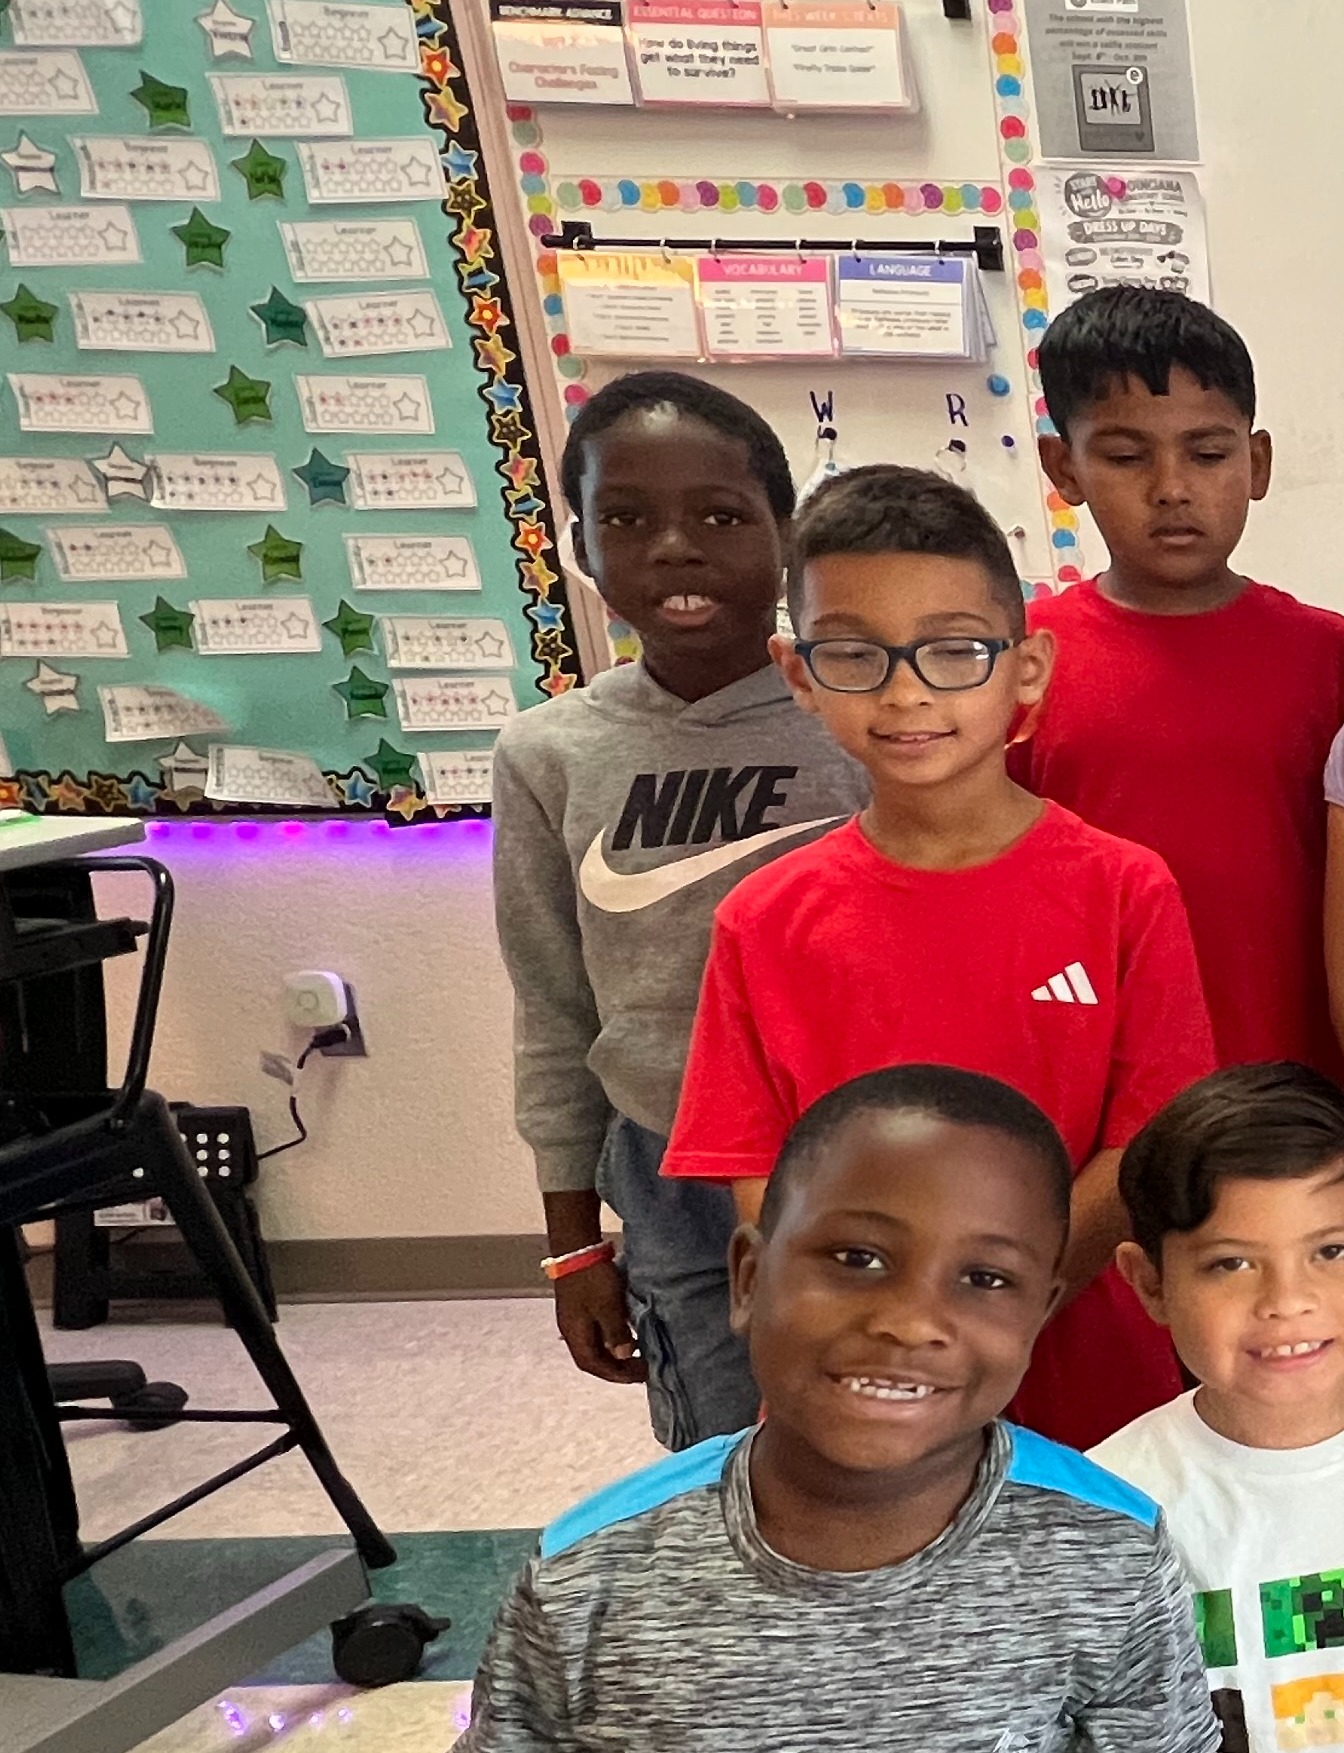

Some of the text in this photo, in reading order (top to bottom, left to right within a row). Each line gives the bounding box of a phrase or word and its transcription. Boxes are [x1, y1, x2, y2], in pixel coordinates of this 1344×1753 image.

[668, 38, 684, 49] do
[1070, 188, 1110, 212] Hello
[722, 264, 803, 276] VOCABULARY
[869, 263, 932, 277] LANGUAGE
[810, 390, 834, 424] W
[945, 392, 968, 427] R
[611, 765, 799, 850] NIKE
